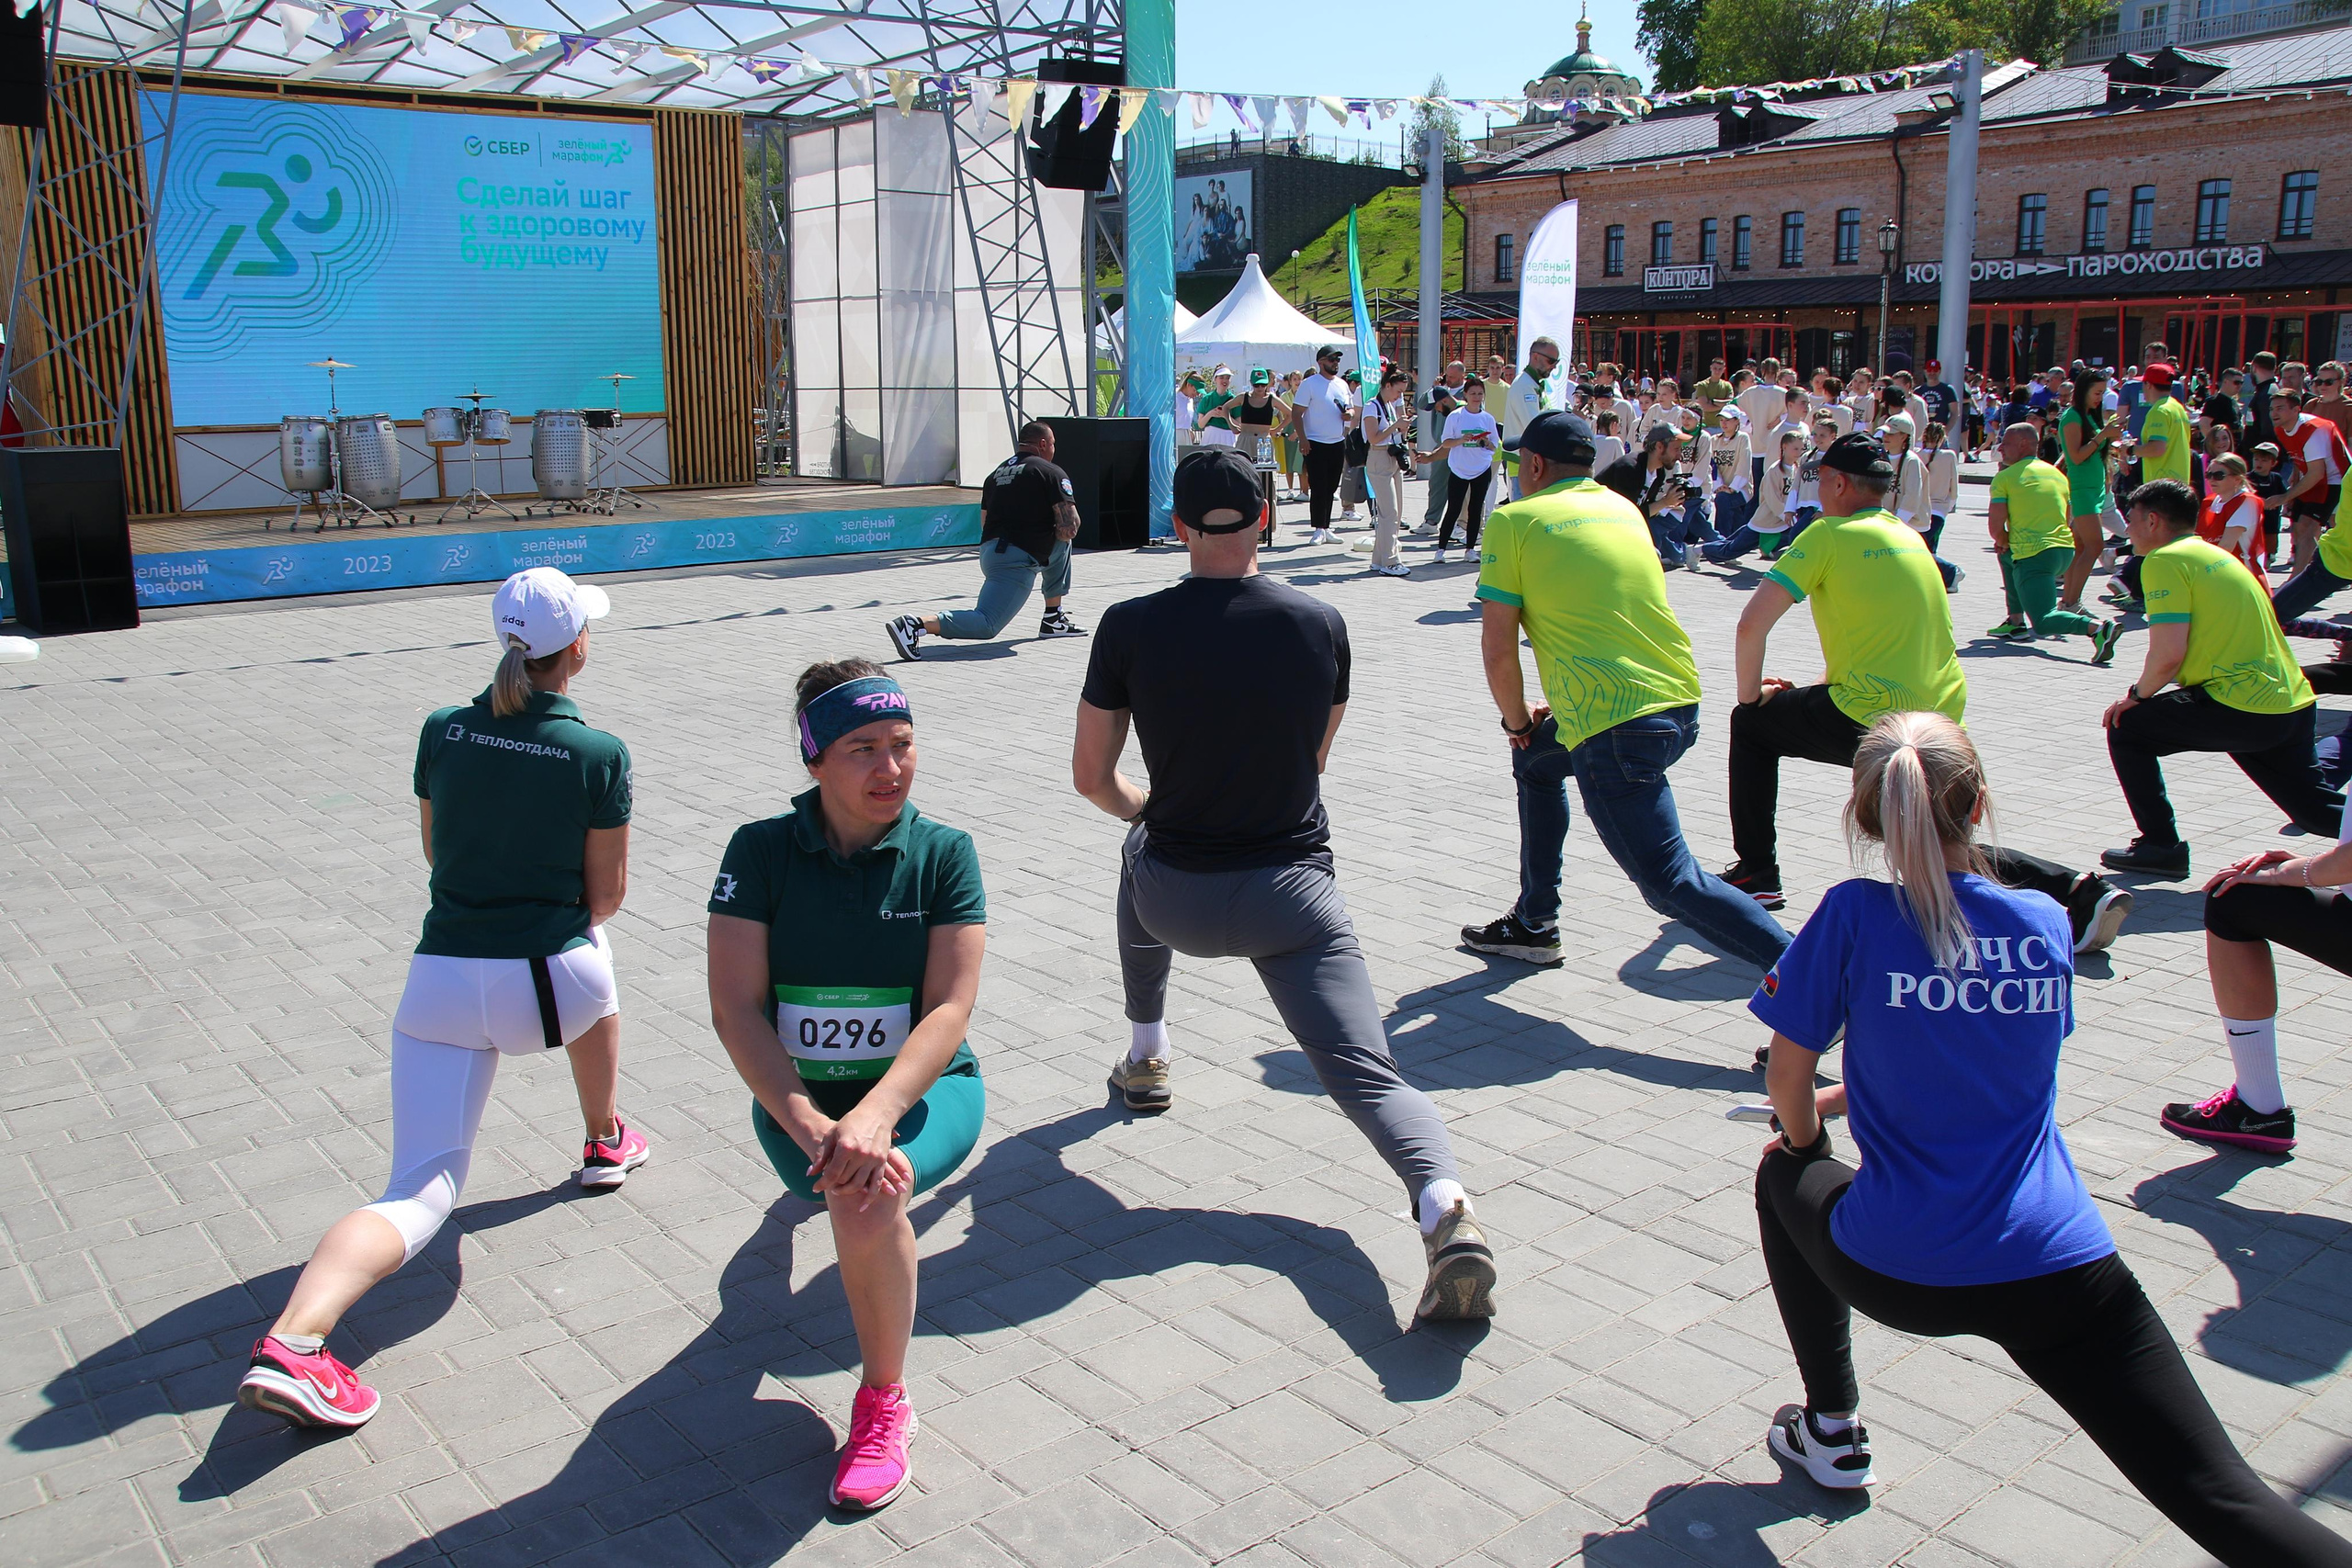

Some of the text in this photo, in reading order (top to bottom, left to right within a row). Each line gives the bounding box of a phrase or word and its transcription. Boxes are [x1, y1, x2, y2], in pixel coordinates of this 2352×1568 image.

[488, 141, 530, 155] СБЕР
[559, 138, 607, 151] зелёный
[552, 151, 604, 163] марафон
[457, 177, 632, 209] Сделай шаг
[460, 214, 646, 244] к здоровому
[460, 235, 609, 272] будущему
[1526, 259, 1571, 272] зелёный
[1905, 260, 2015, 284] КООРА
[1526, 273, 1571, 287] марафон
[1648, 268, 1709, 288] КОНТОРА
[842, 514, 896, 531] зелёный
[521, 535, 588, 552] зелёный
[695, 533, 736, 549] 2023
[835, 531, 891, 545] марафон
[344, 555, 392, 575] 2023
[514, 551, 582, 568] марафон
[134, 558, 209, 579] елёный
[135, 578, 204, 597] арафон
[502, 615, 526, 627] didas
[469, 732, 571, 761] ТЕПЛООТДАЧА
[799, 1018, 886, 1049] 0296
